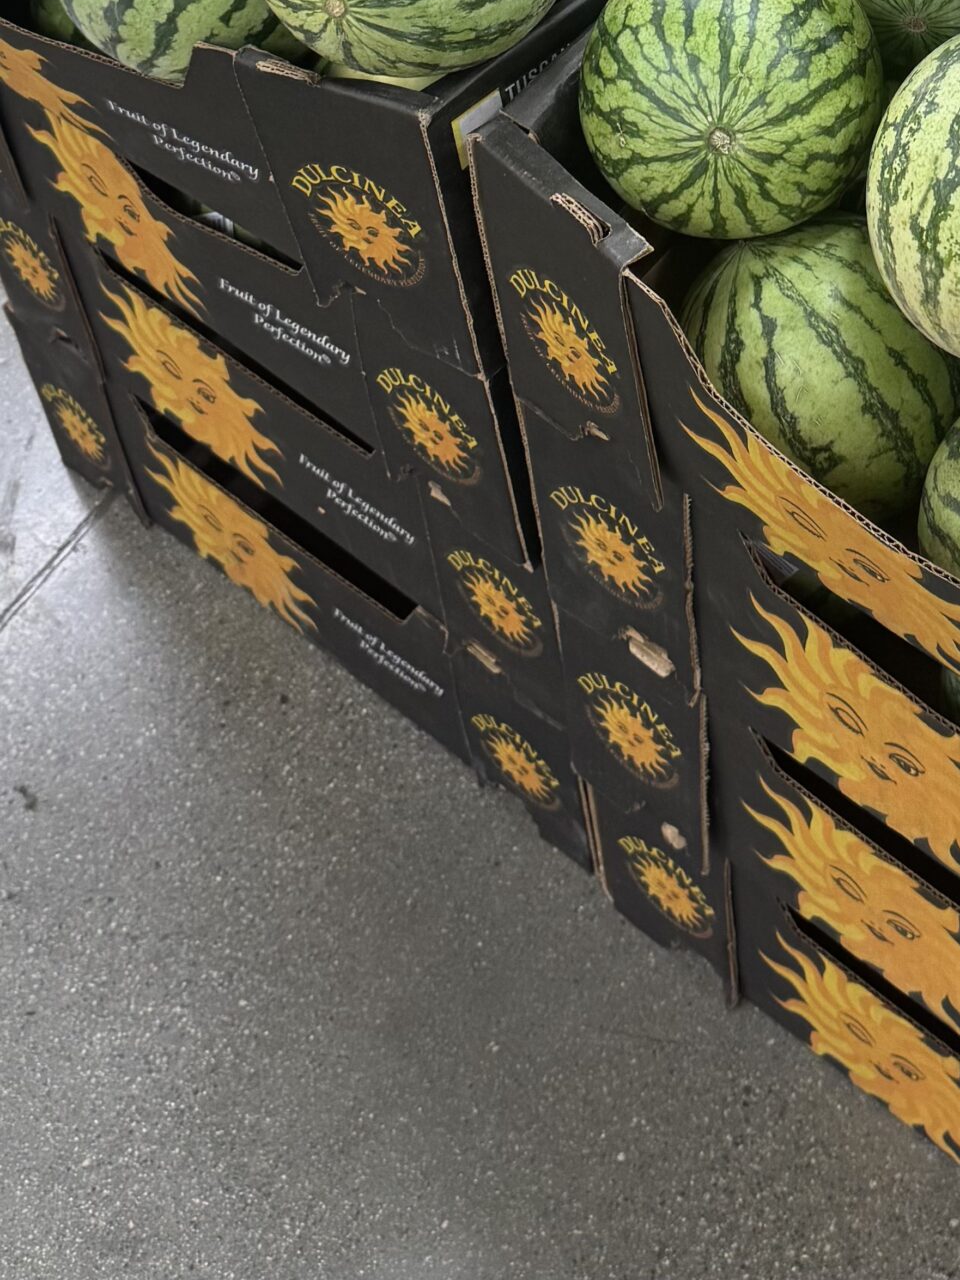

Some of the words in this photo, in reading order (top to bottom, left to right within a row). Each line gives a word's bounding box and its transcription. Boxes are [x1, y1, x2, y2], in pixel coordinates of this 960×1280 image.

[107, 100, 150, 126] Fruit
[152, 122, 168, 137] of
[171, 128, 259, 180] Legendary
[291, 163, 422, 239] DULCINEA
[219, 277, 257, 305] Fruit
[258, 302, 274, 317] of
[275, 309, 351, 364] Legendary
[508, 269, 618, 375] DULCINEA
[376, 367, 479, 449] DULCINEA
[299, 453, 331, 481] Fruit
[332, 480, 347, 494] of
[348, 486, 415, 546] Legendary
[550, 485, 666, 575] DULCINEA
[447, 549, 543, 628] DULCINEA
[577, 671, 682, 758] DULCINEA
